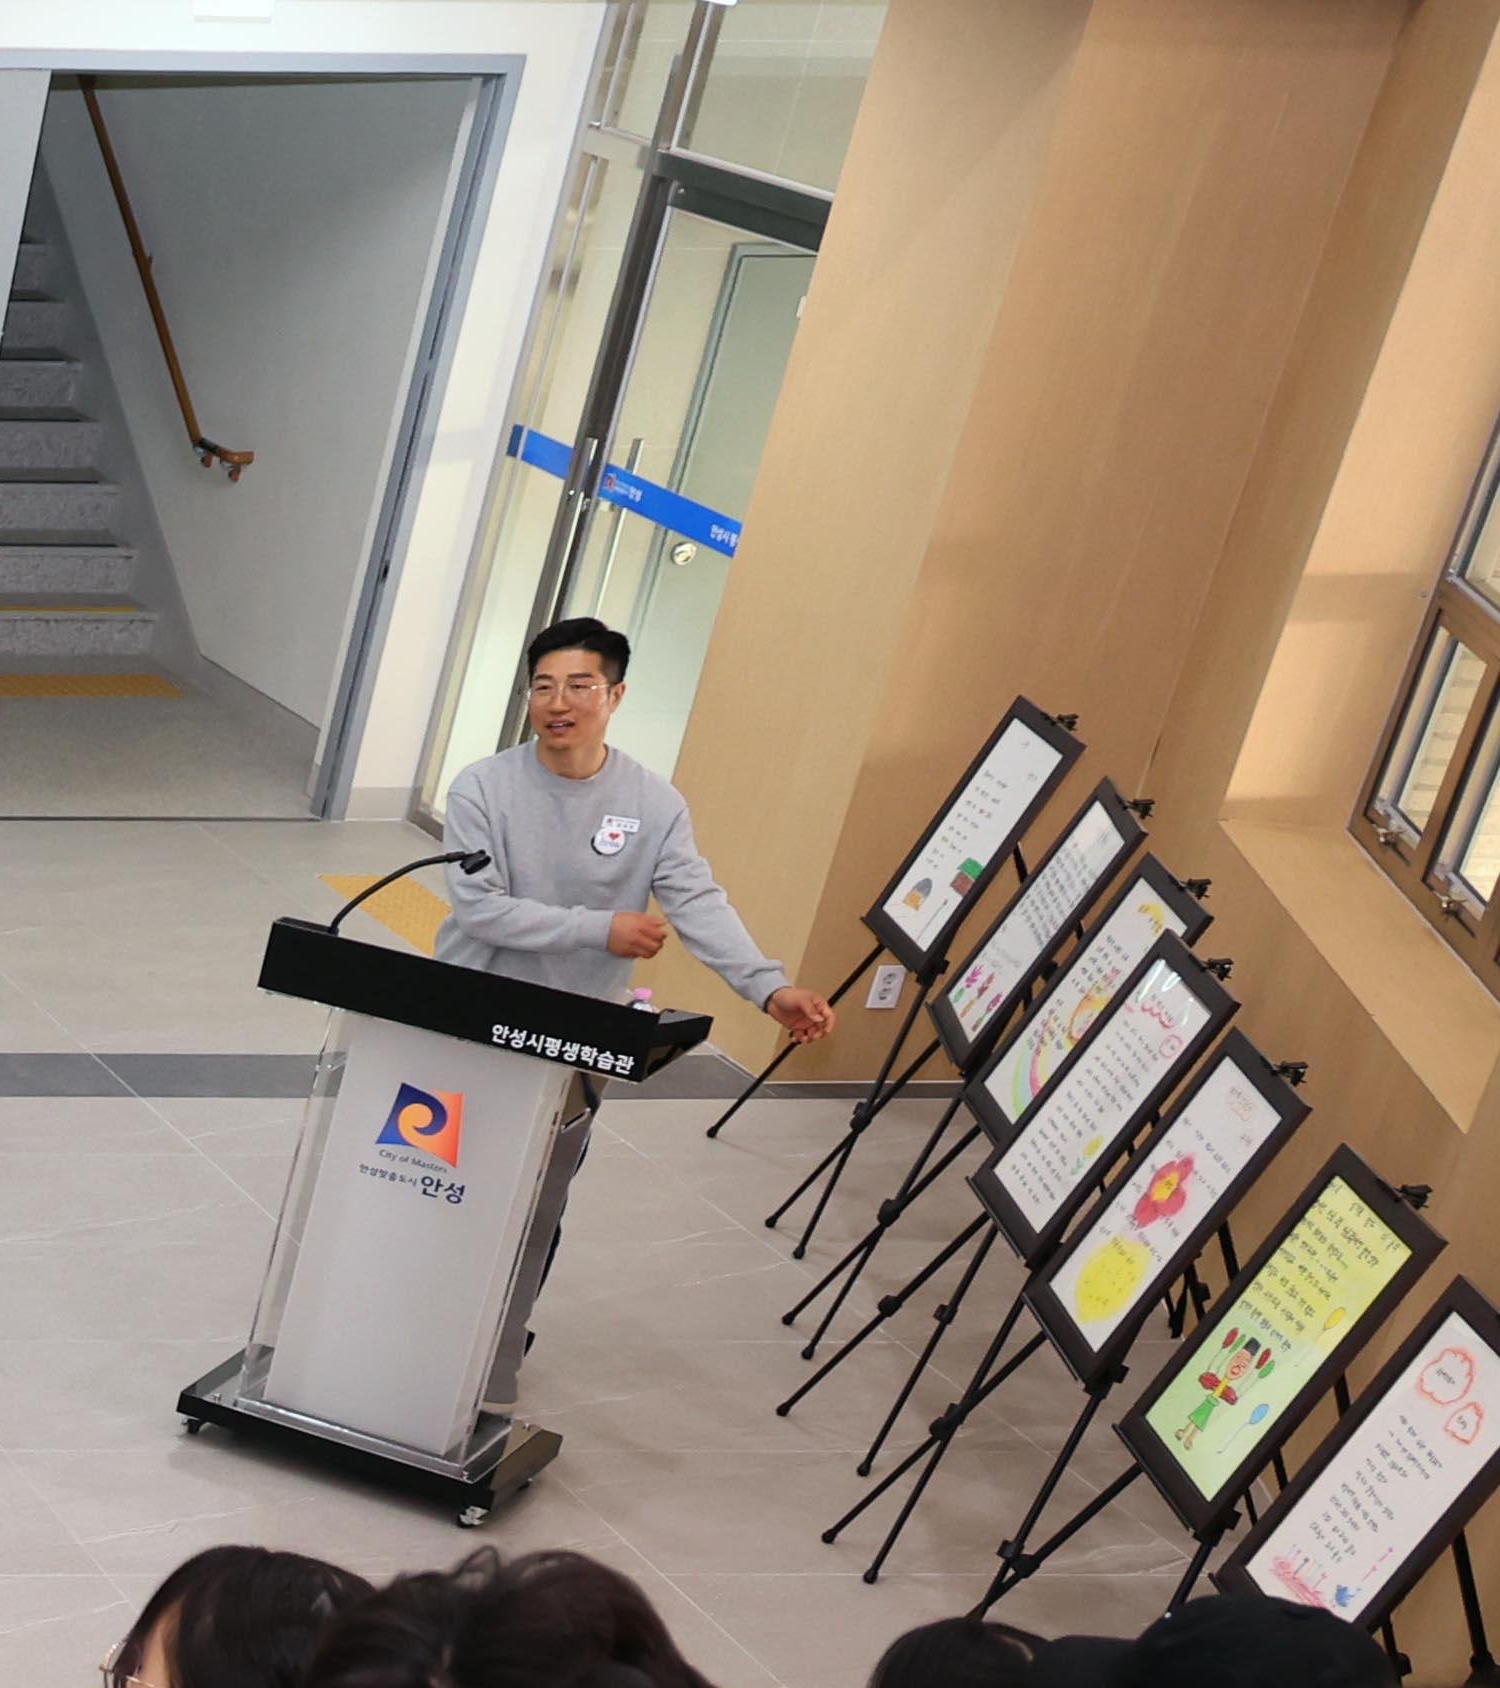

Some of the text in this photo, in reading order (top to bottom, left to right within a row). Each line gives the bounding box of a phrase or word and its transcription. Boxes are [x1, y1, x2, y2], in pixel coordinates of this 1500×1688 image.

[491, 1023, 636, 1076] 안성시평생학습관
[379, 1148, 448, 1175] City of Masters
[420, 1175, 467, 1205] 안성
